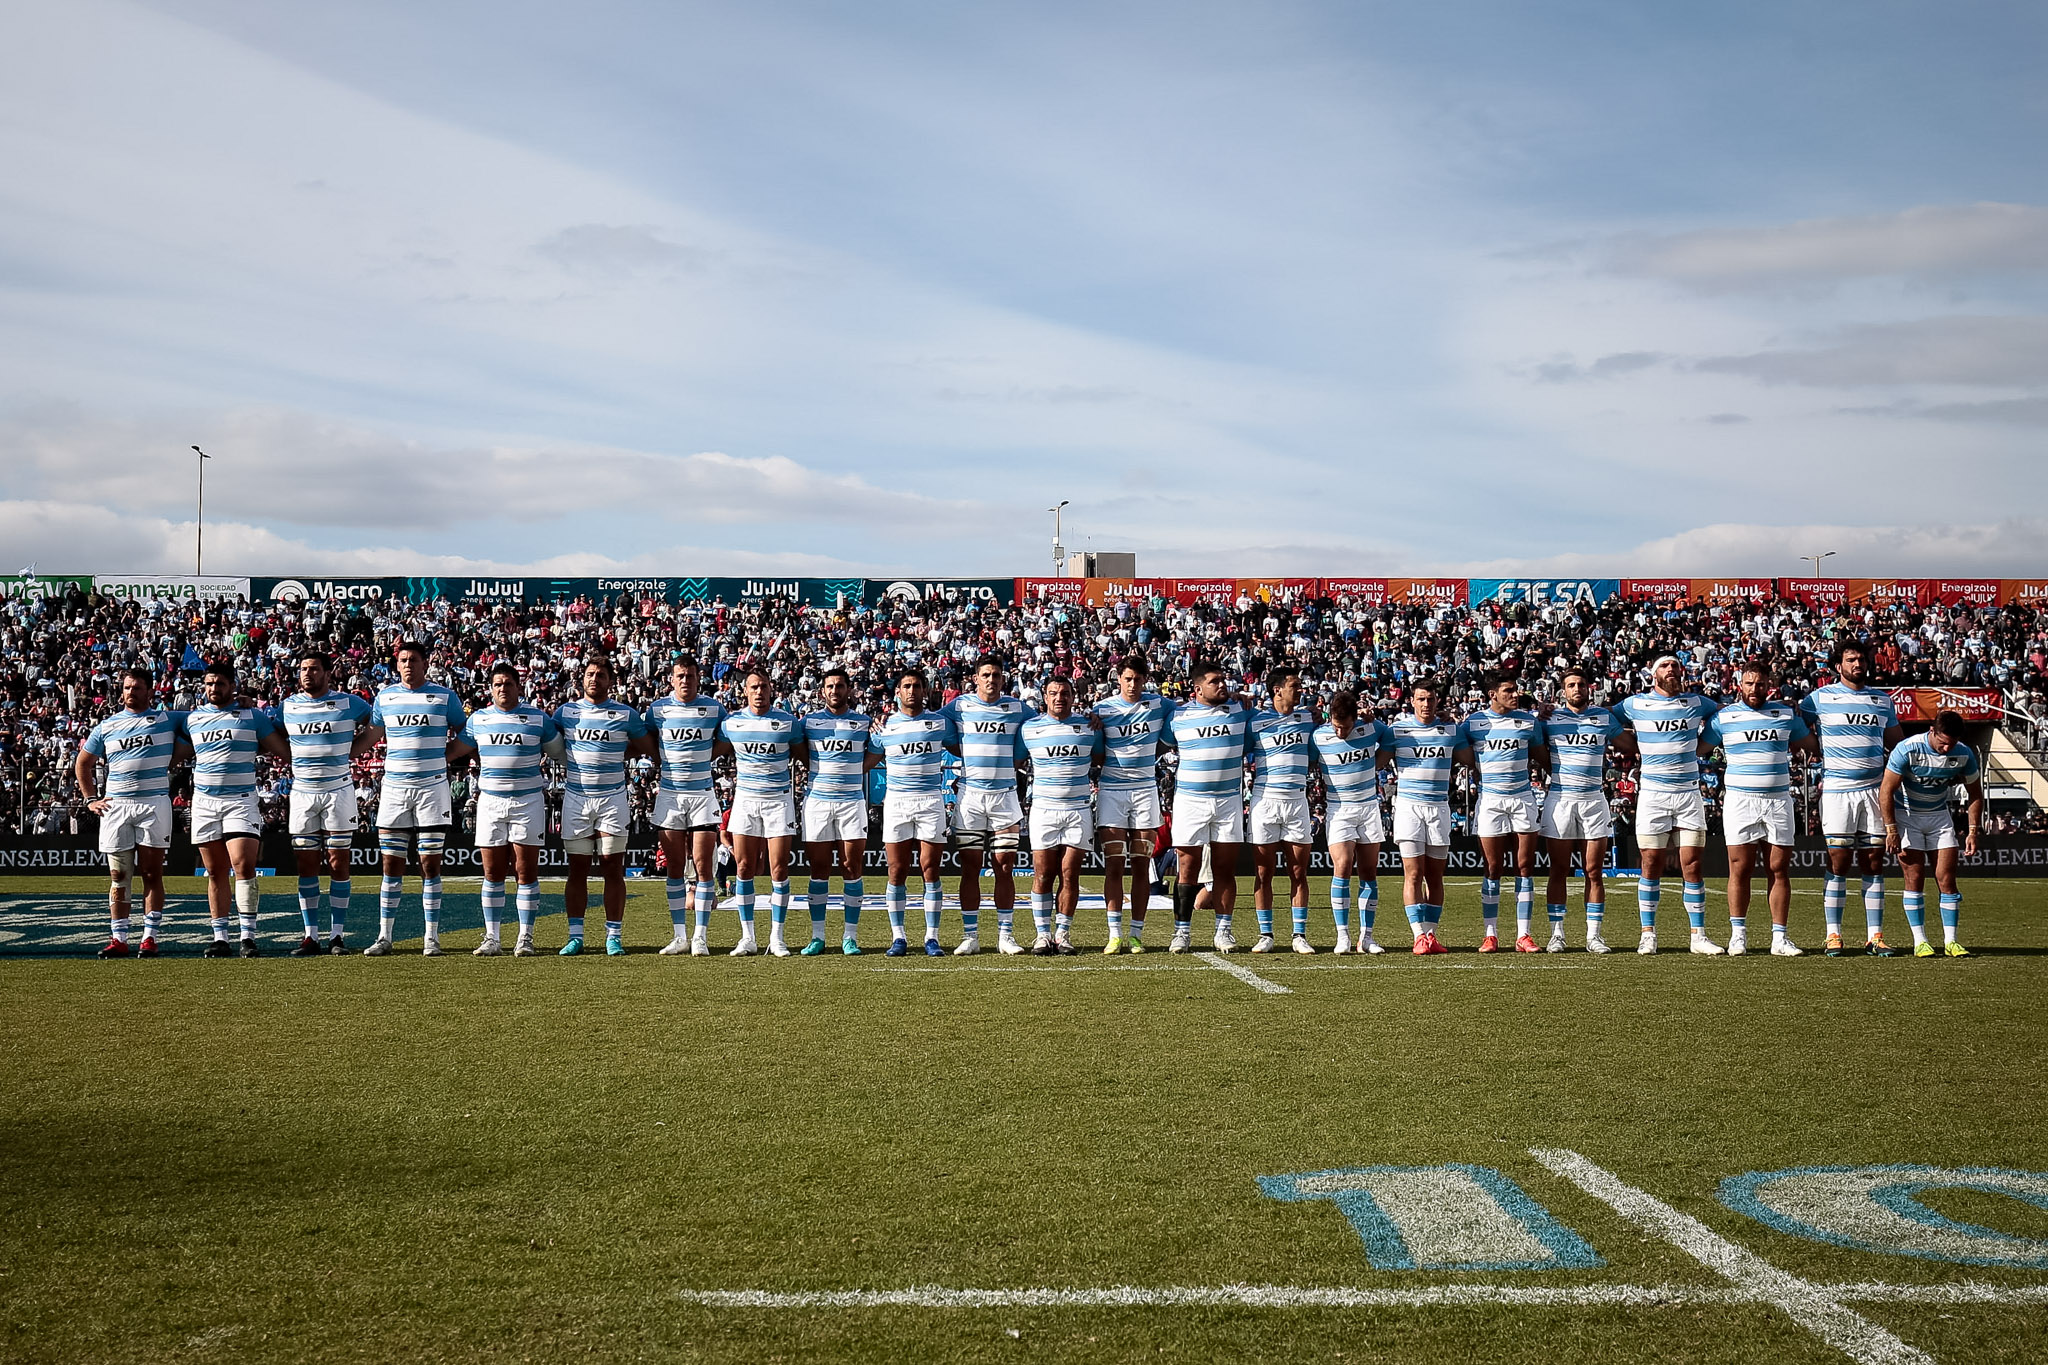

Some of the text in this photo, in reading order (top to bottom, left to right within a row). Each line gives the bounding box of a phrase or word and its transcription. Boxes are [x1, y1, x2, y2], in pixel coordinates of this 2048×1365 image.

[314, 582, 382, 600] Macro
[598, 579, 667, 593] Energizate
[1177, 582, 1233, 593] Energizate
[1790, 581, 1846, 593] Energizate
[1941, 582, 1997, 594] Energizate
[396, 714, 430, 726] VISA
[1655, 719, 1689, 732] VISA
[1844, 713, 1879, 726] VISA
[297, 722, 332, 733] VISA
[974, 722, 1006, 733] VISA
[1117, 722, 1150, 736] VISA
[1196, 725, 1231, 737] VISA
[201, 729, 233, 742] VISA
[490, 734, 523, 745] VISA
[577, 729, 610, 741] VISA
[669, 728, 702, 740] VISA
[1272, 733, 1303, 746] VISA
[1564, 734, 1598, 745] VISA
[1744, 729, 1779, 741] VISA
[118, 735, 154, 750] VISA
[743, 743, 776, 754] VISA
[821, 740, 853, 752] VISA
[900, 742, 933, 755] VISA
[1488, 738, 1520, 750] VISA
[1046, 746, 1080, 757] VISA
[1337, 749, 1370, 764] VISA
[1412, 747, 1446, 758] VISA
[0, 850, 168, 867] NSABLEM
